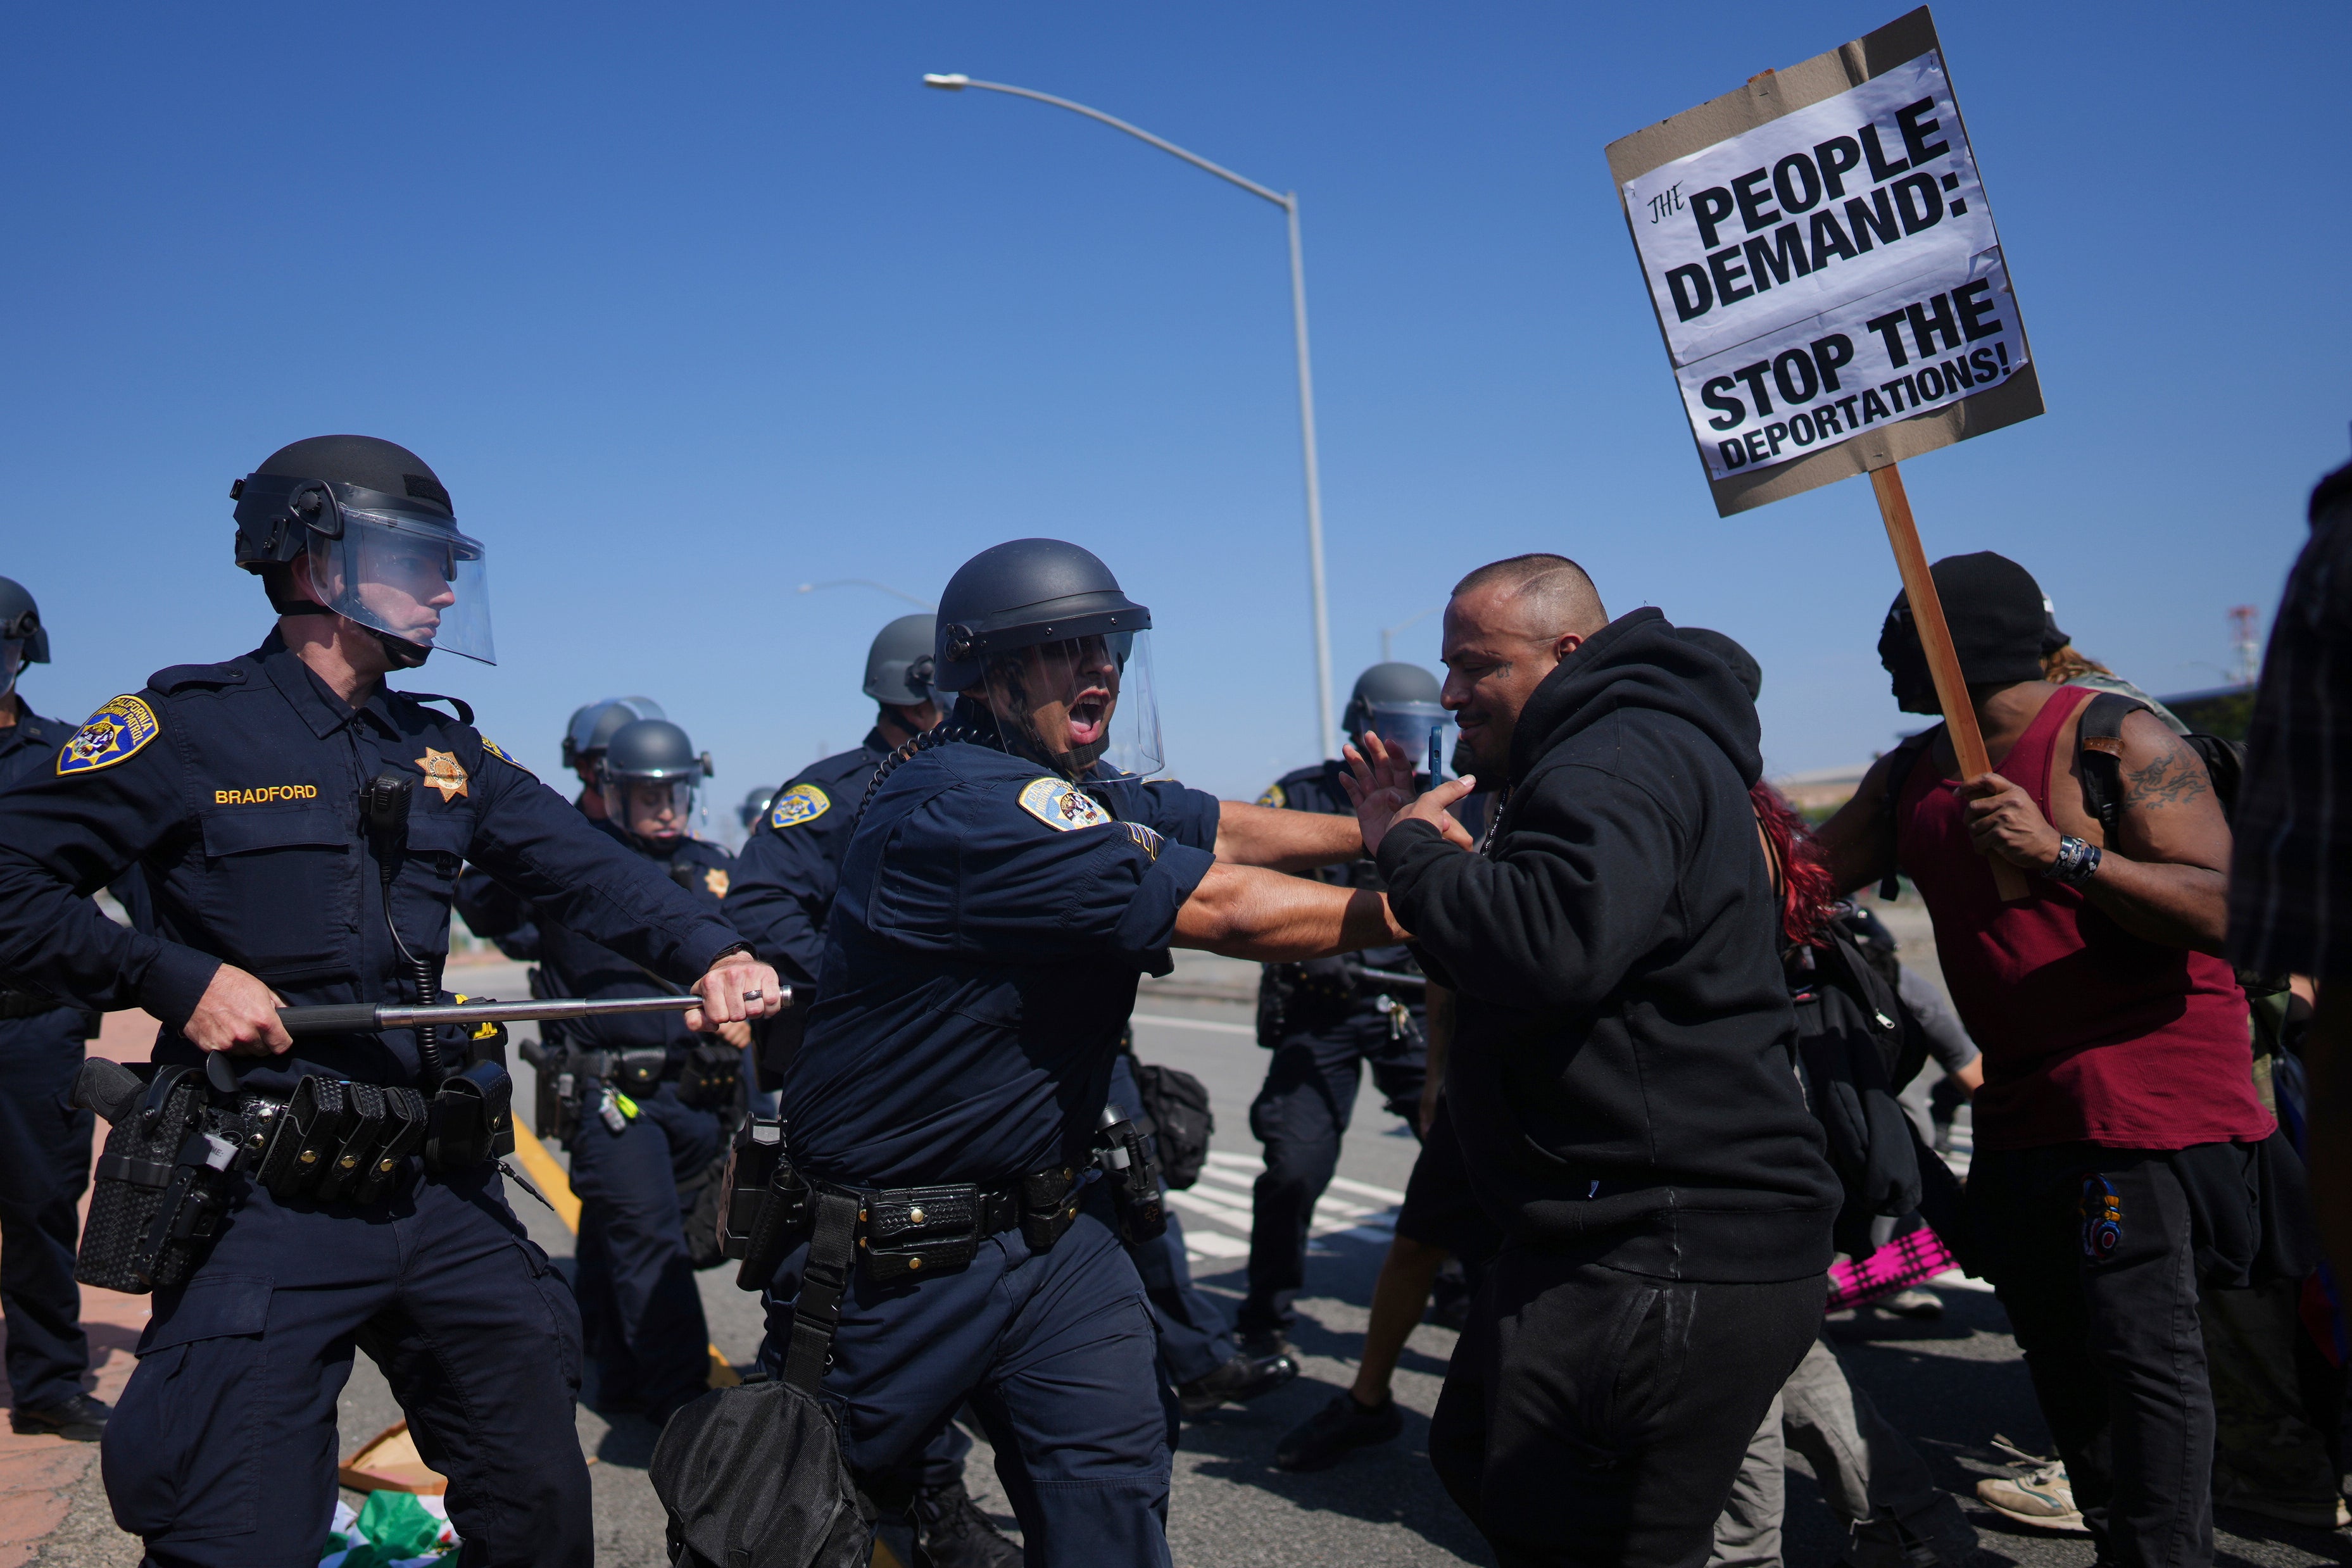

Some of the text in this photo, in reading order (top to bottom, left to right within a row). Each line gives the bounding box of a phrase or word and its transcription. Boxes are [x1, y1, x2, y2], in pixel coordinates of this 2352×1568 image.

[1647, 96, 1951, 250] THE PEOPLE
[1665, 172, 1968, 323] DEMAND:
[1701, 277, 2003, 431] STOP THE
[1718, 342, 2011, 470] DEPORTATIONS!
[110, 699, 153, 732] CALIFORNIA
[123, 713, 144, 745] PATROL
[215, 785, 317, 805] BRADFORD
[440, 756, 460, 772] HIGHWAY
